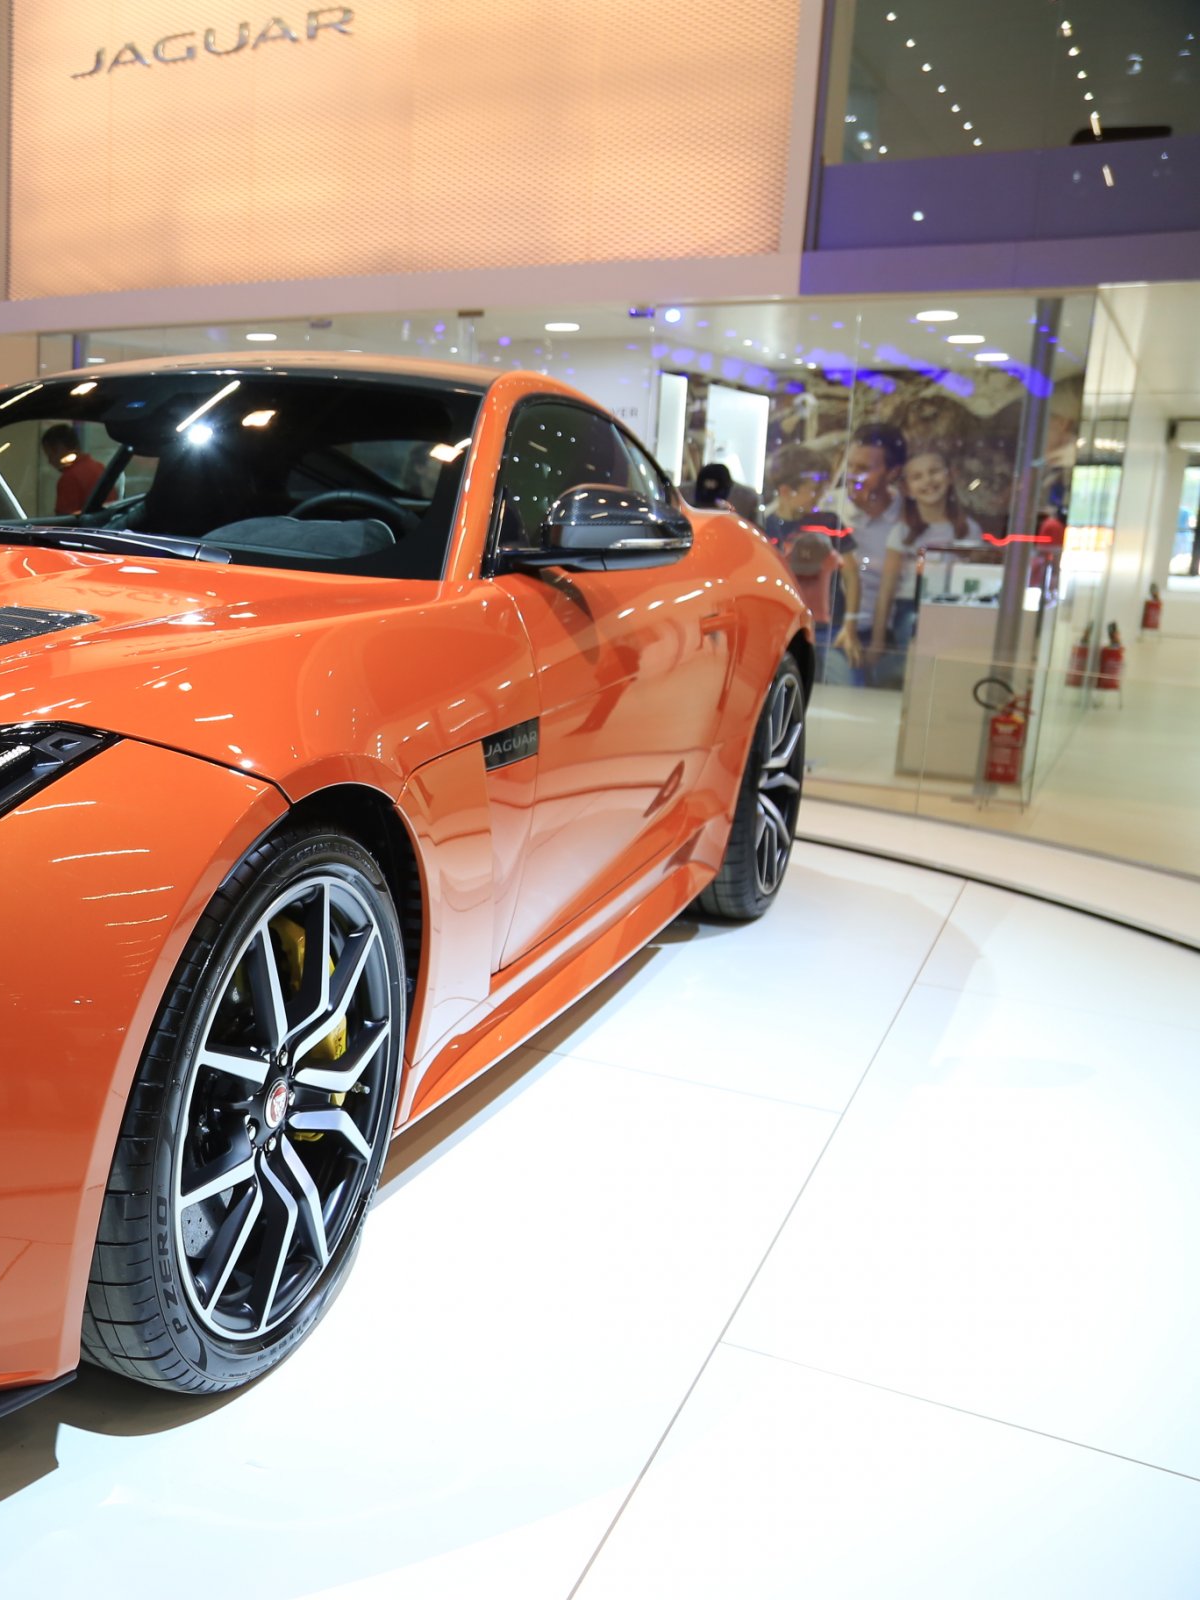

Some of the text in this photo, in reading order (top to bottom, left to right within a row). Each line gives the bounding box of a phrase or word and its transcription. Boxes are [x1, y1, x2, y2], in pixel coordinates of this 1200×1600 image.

[71, 7, 354, 78] JAGUAR
[484, 731, 538, 757] JAGUAR
[157, 1195, 188, 1334] P ZERO
